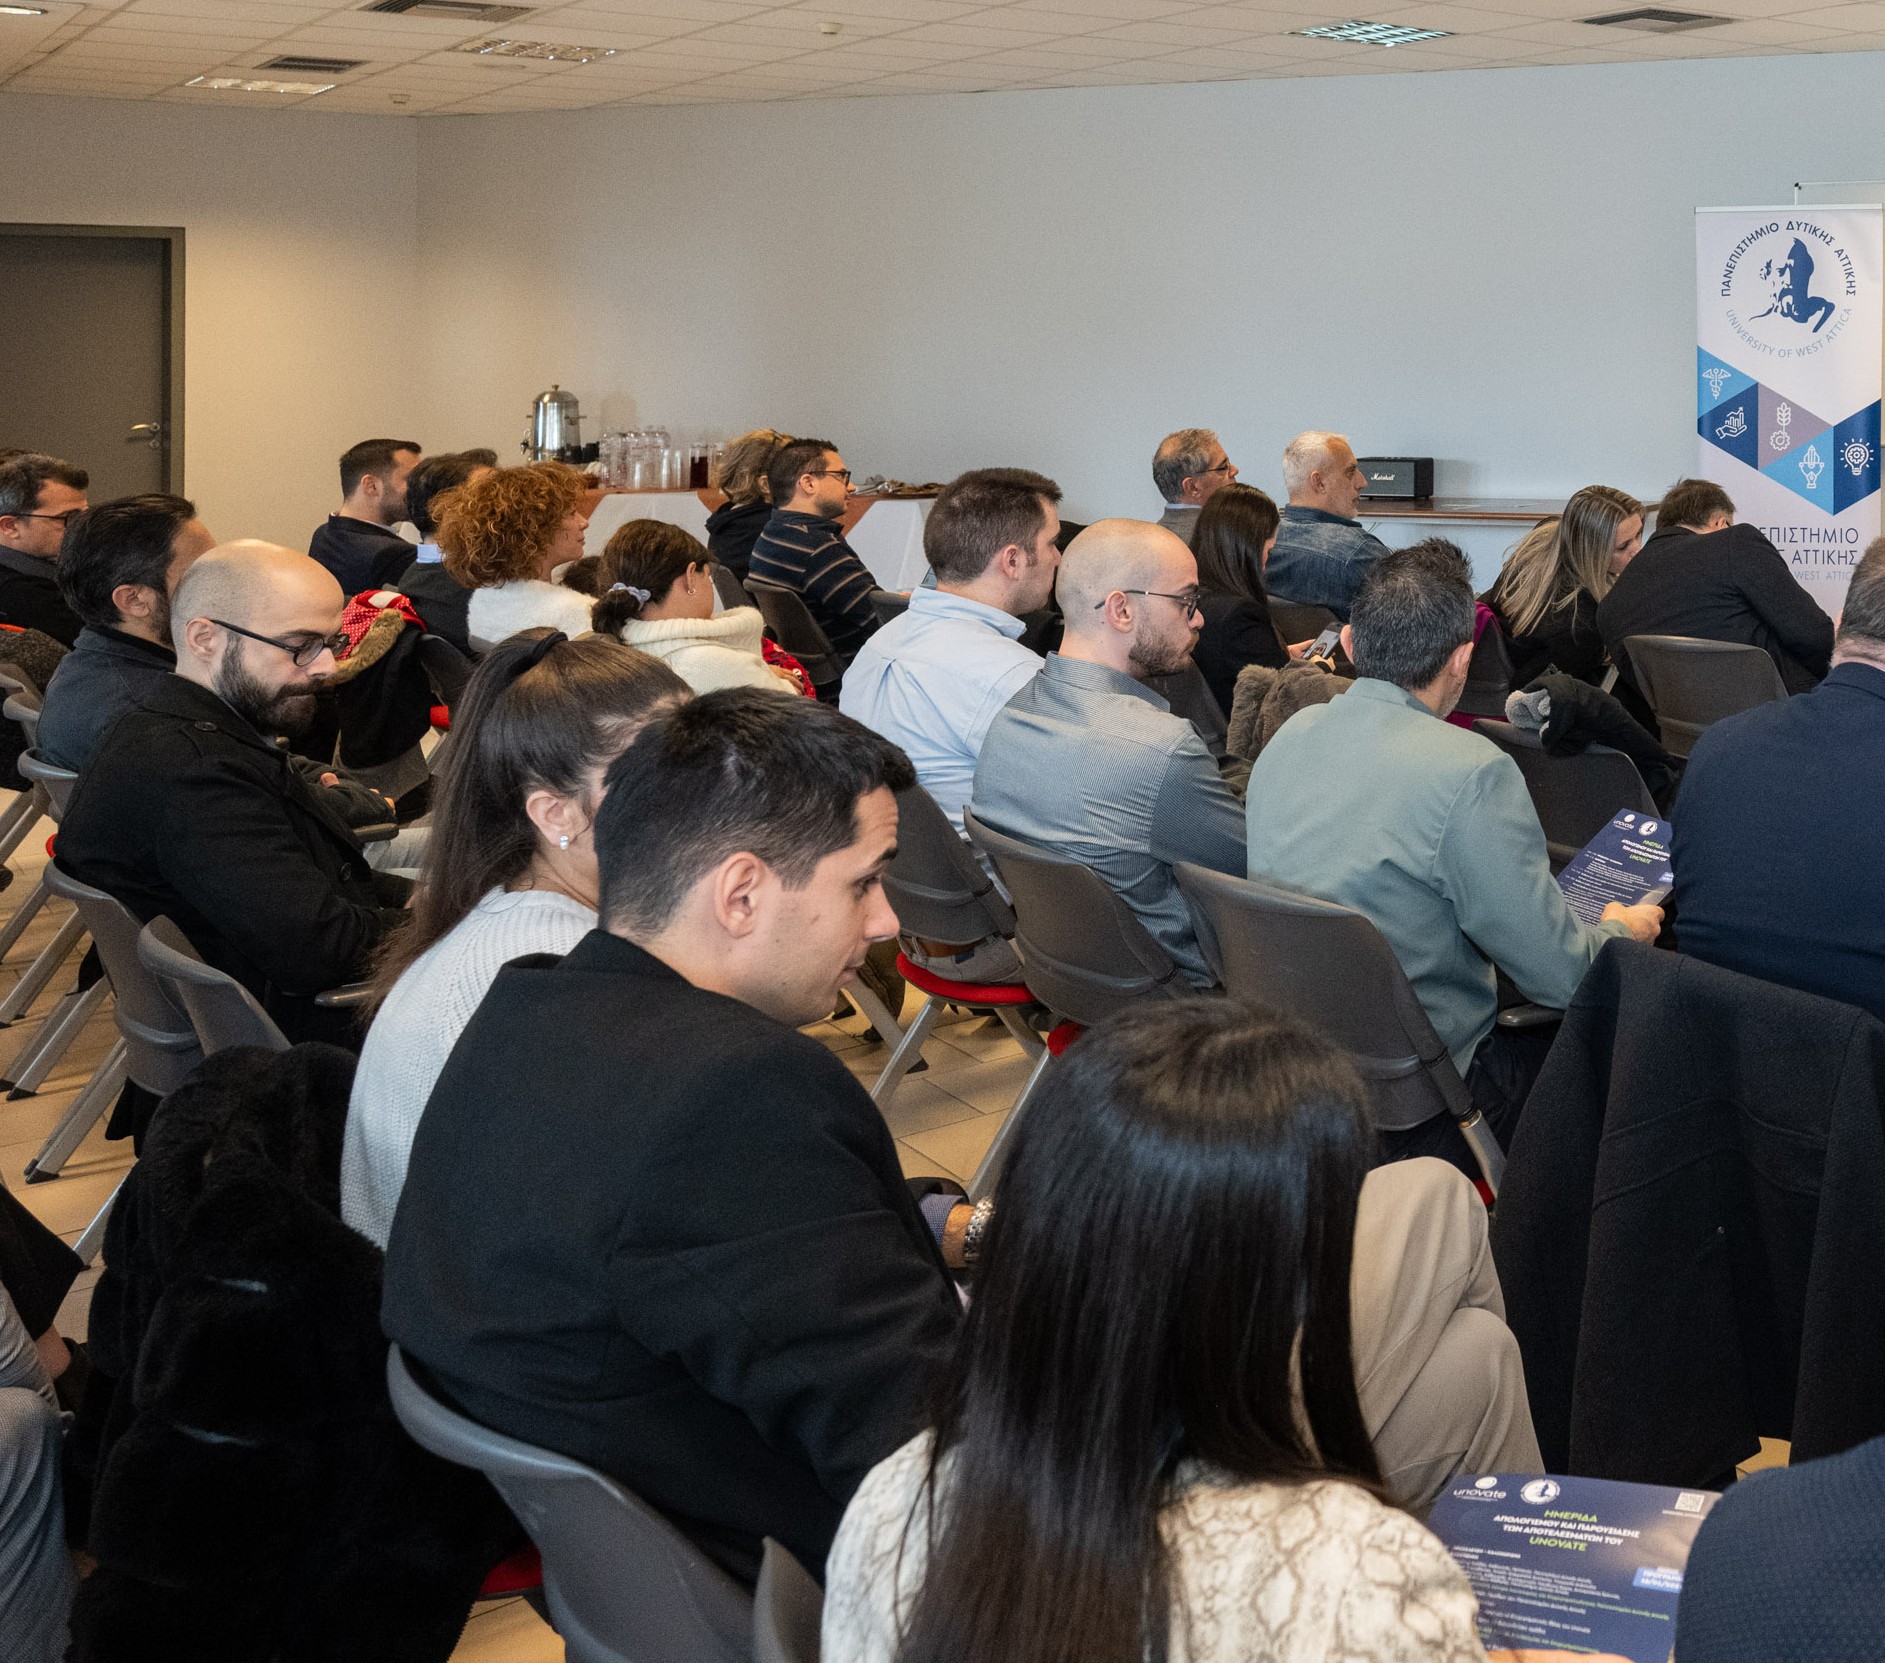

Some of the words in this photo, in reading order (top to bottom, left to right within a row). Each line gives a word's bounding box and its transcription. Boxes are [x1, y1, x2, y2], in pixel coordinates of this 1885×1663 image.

[1721, 222, 1779, 297] ΠΑΝΕΠΙΣΤΗΜΙΟ
[1785, 220, 1836, 247] ΔΥΤΙΚΗΣ
[1833, 248, 1857, 297] ΑΤΤΙΚΗΣ
[1726, 308, 1776, 357] UNIVERSITY
[1777, 348, 1793, 358] OF
[1795, 340, 1824, 358] WEST
[1825, 307, 1853, 343] ATTICA
[1791, 549, 1858, 566] ΑΤΤΙΚΗΣ
[1826, 570, 1852, 580] ATTIC
[1453, 1488, 1507, 1500] unovate
[1544, 1509, 1598, 1523] ΗΜΕΡΙΔΑ
[1493, 1514, 1560, 1528] ΑΠΟΛΟΓΙΣΜΟΥ
[1560, 1521, 1577, 1530] ΚΑΙ
[1577, 1523, 1641, 1539] ΠΑΡΟΥΣΙΑΣΗΣ
[1502, 1524, 1523, 1533] ΤΩΝ
[1523, 1526, 1603, 1543] ΑΠΟΤΕΛΕΣΜΑΤΩΝ
[1604, 1536, 1624, 1546] ΤΟΥ
[1529, 1536, 1588, 1552] UNOVATE
